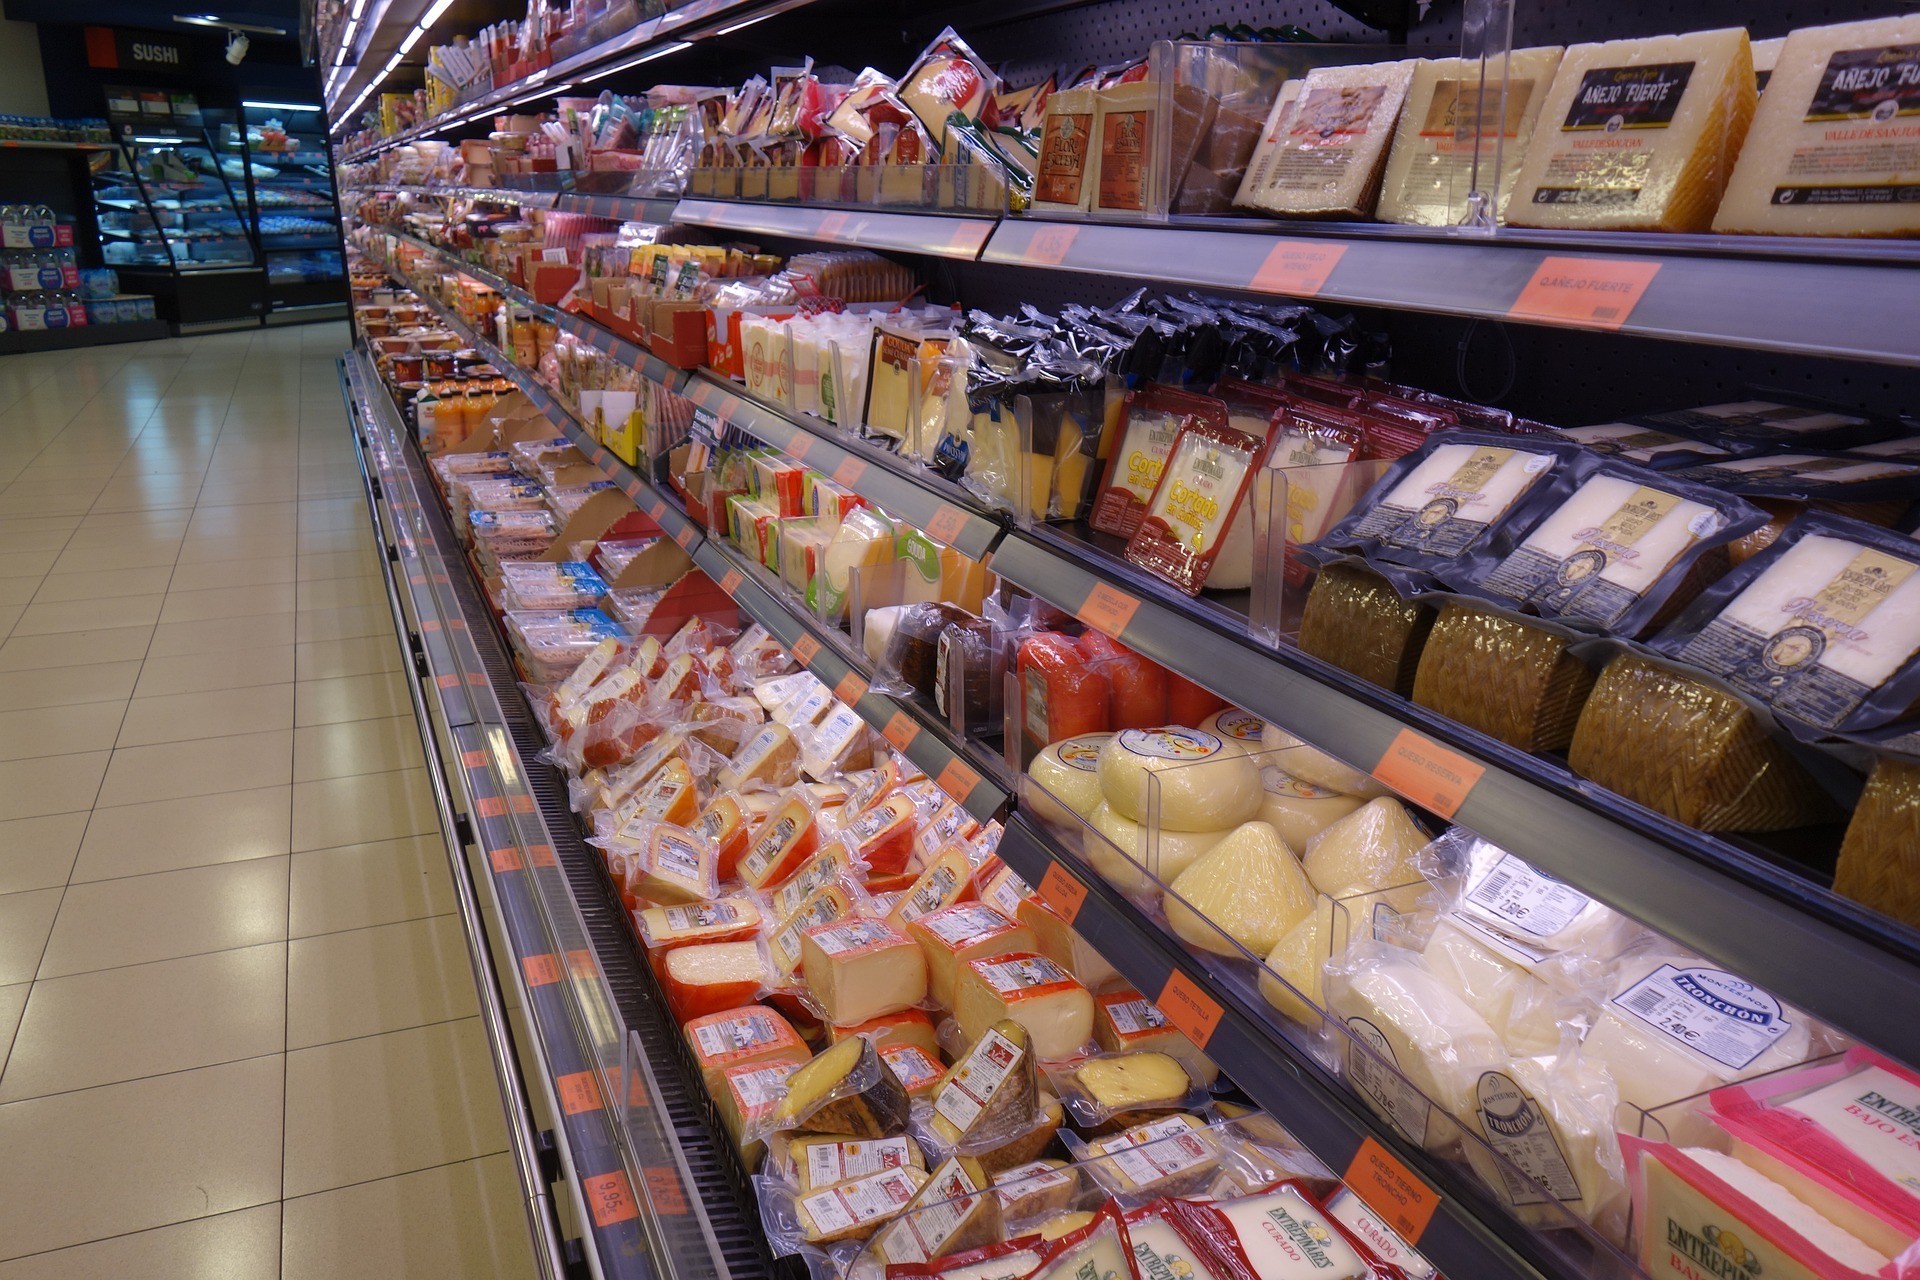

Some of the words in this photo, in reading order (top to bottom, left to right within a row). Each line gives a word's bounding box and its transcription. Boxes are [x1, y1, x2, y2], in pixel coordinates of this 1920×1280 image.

[132, 43, 179, 64] SUSHI
[1582, 85, 1622, 104] AÑEJO
[1831, 67, 1890, 91] AÑEJO
[1825, 129, 1857, 140] VALLE
[1859, 128, 1874, 139] DE
[1876, 127, 1896, 138] SAN
[1588, 280, 1633, 293] FUERTE
[1128, 451, 1164, 477] Cort
[1166, 503, 1177, 516] en
[1170, 480, 1219, 520] Cortado
[1172, 985, 1190, 1004] QUESO
[1676, 977, 1764, 1024] TRONCHÓN
[1697, 974, 1769, 1010] MONTESINOS
[1844, 1105, 1896, 1136] BAJO
[1369, 1153, 1396, 1179] QUESO
[1394, 1176, 1423, 1205] TIERNO
[1372, 1172, 1408, 1207] TRONCHO
[1262, 1221, 1301, 1262] CURADO
[1269, 1206, 1334, 1269] ENTREPINARES
[1357, 1217, 1398, 1258] CURADO
